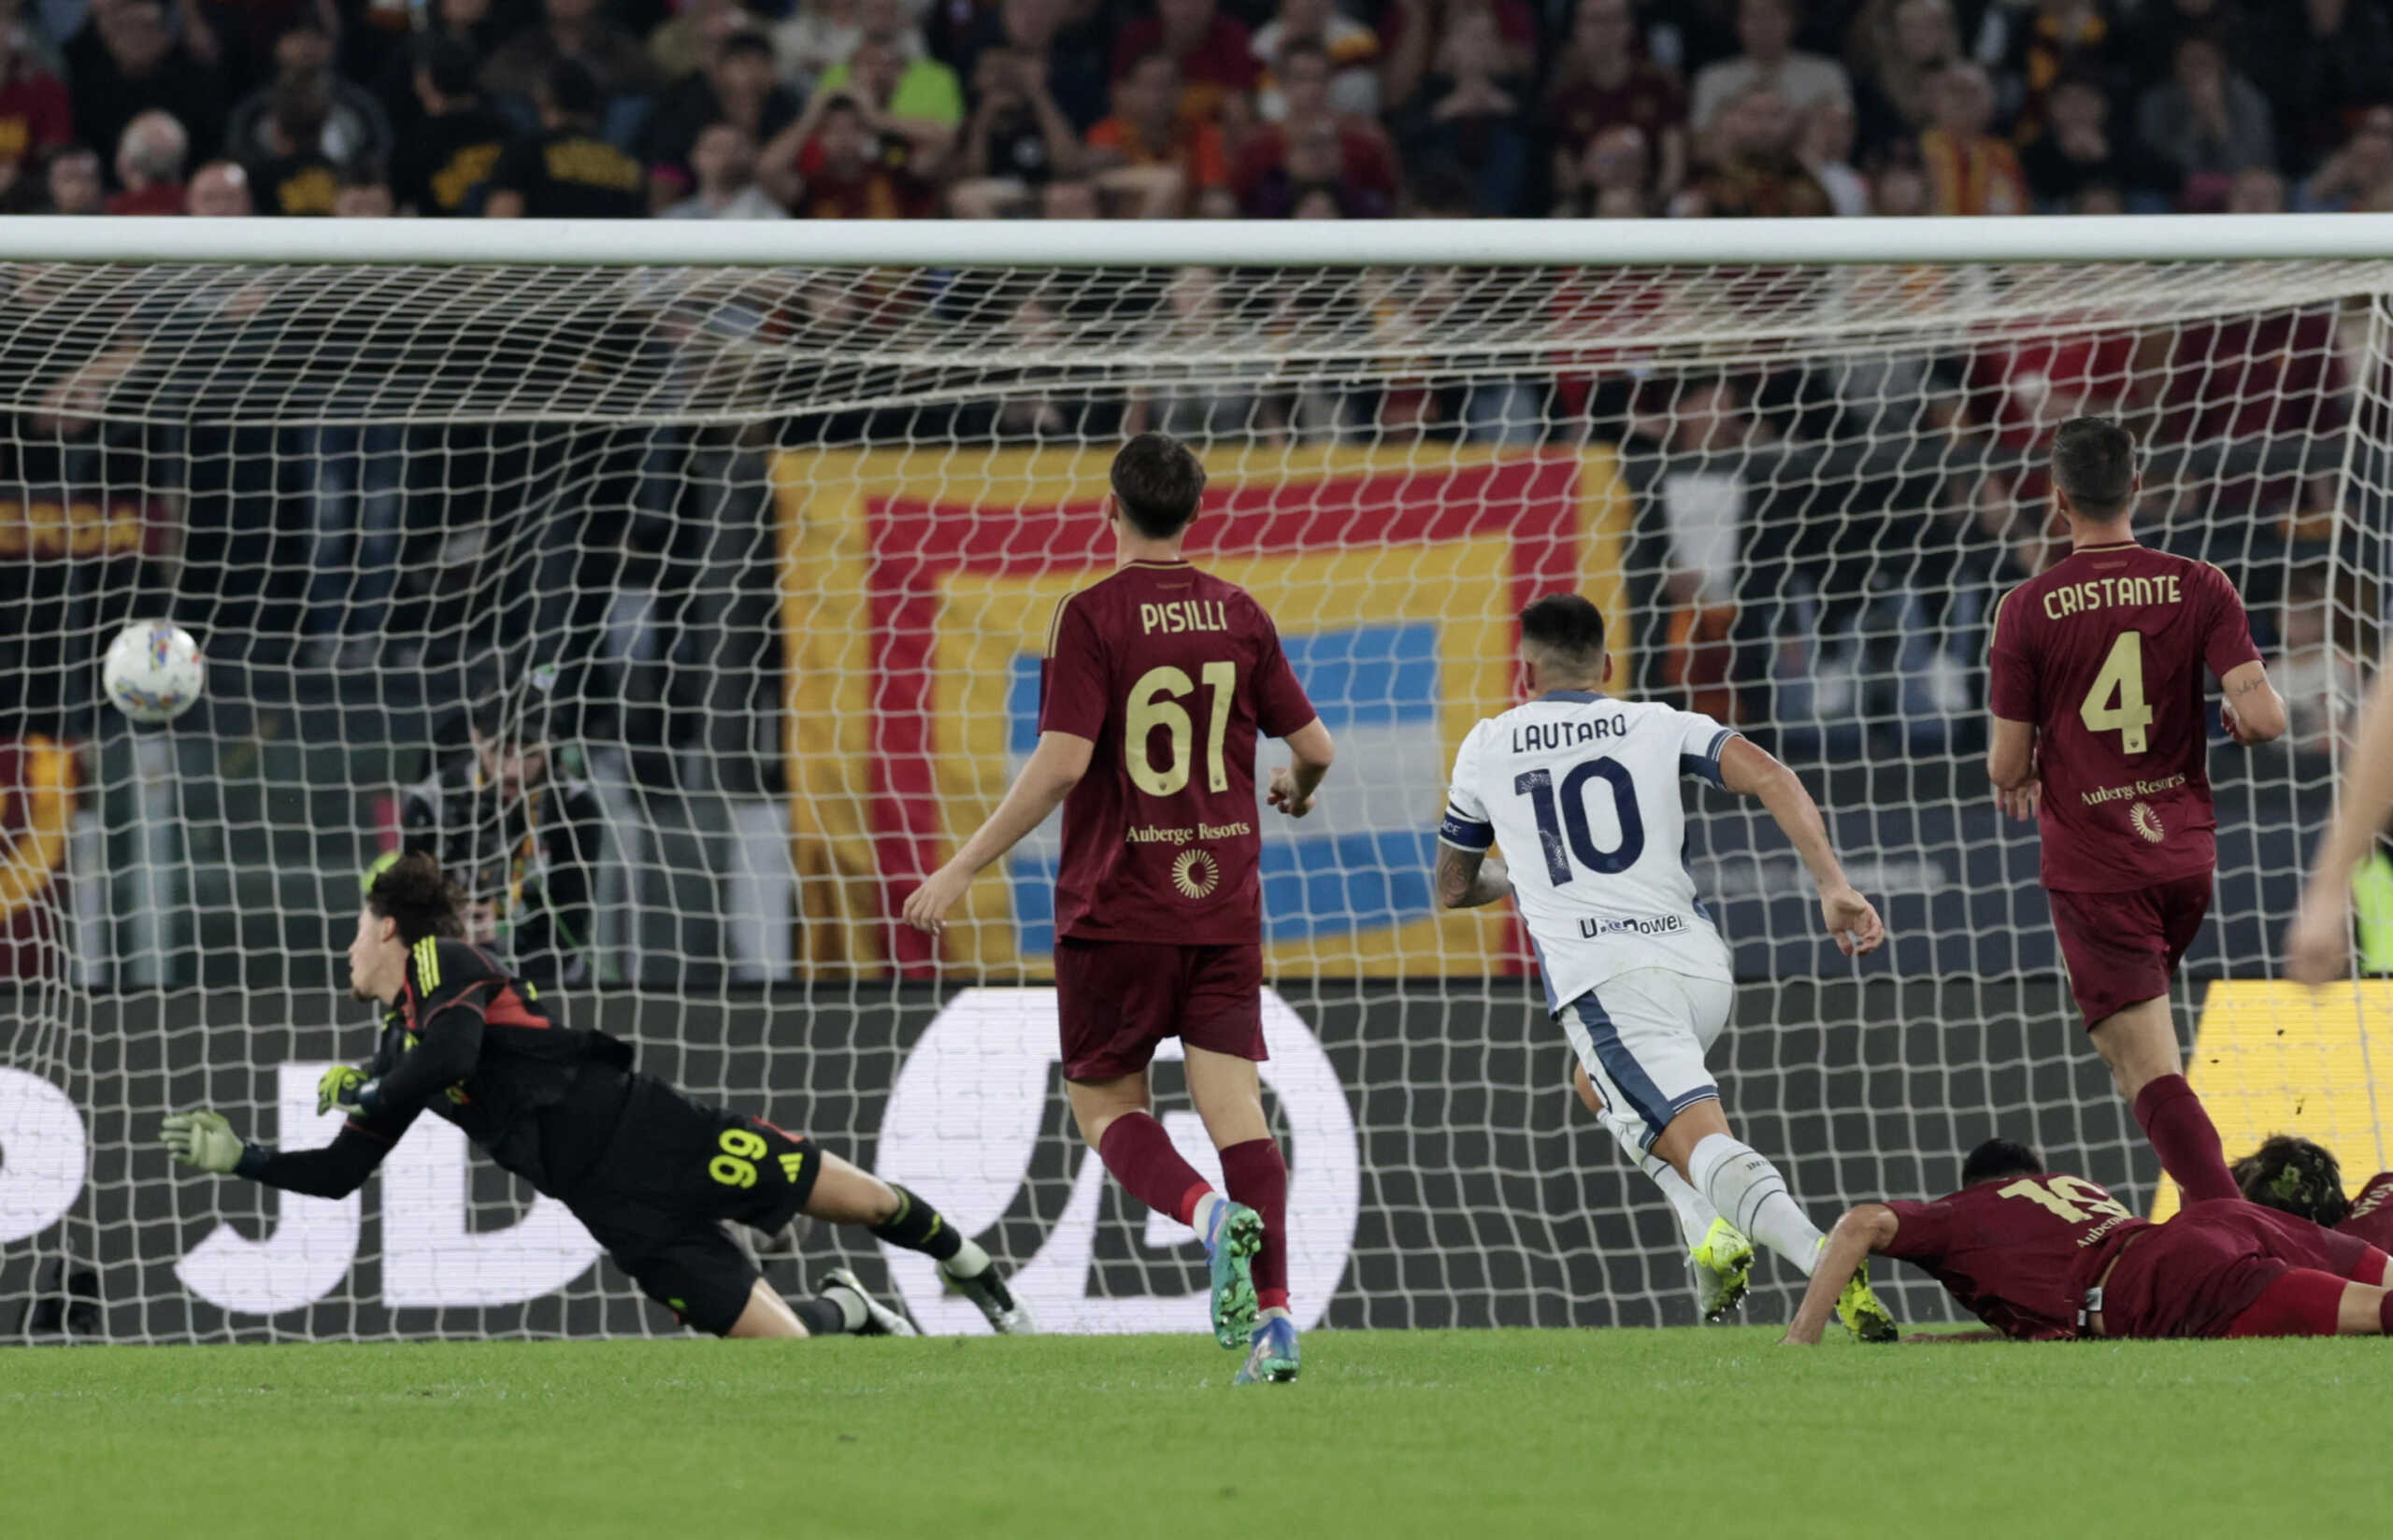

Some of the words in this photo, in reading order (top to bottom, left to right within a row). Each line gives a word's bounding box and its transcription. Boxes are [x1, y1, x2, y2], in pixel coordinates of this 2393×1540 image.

[1140, 600, 1228, 635] PISILLI
[2042, 576, 2182, 620] CRISTANTE
[2080, 631, 2154, 754] 4
[1125, 661, 1237, 797] 61
[1512, 713, 1627, 754] LAUTARO
[1125, 823, 1194, 847] Auberge
[1513, 755, 1645, 889] 10
[709, 1128, 768, 1190] 99
